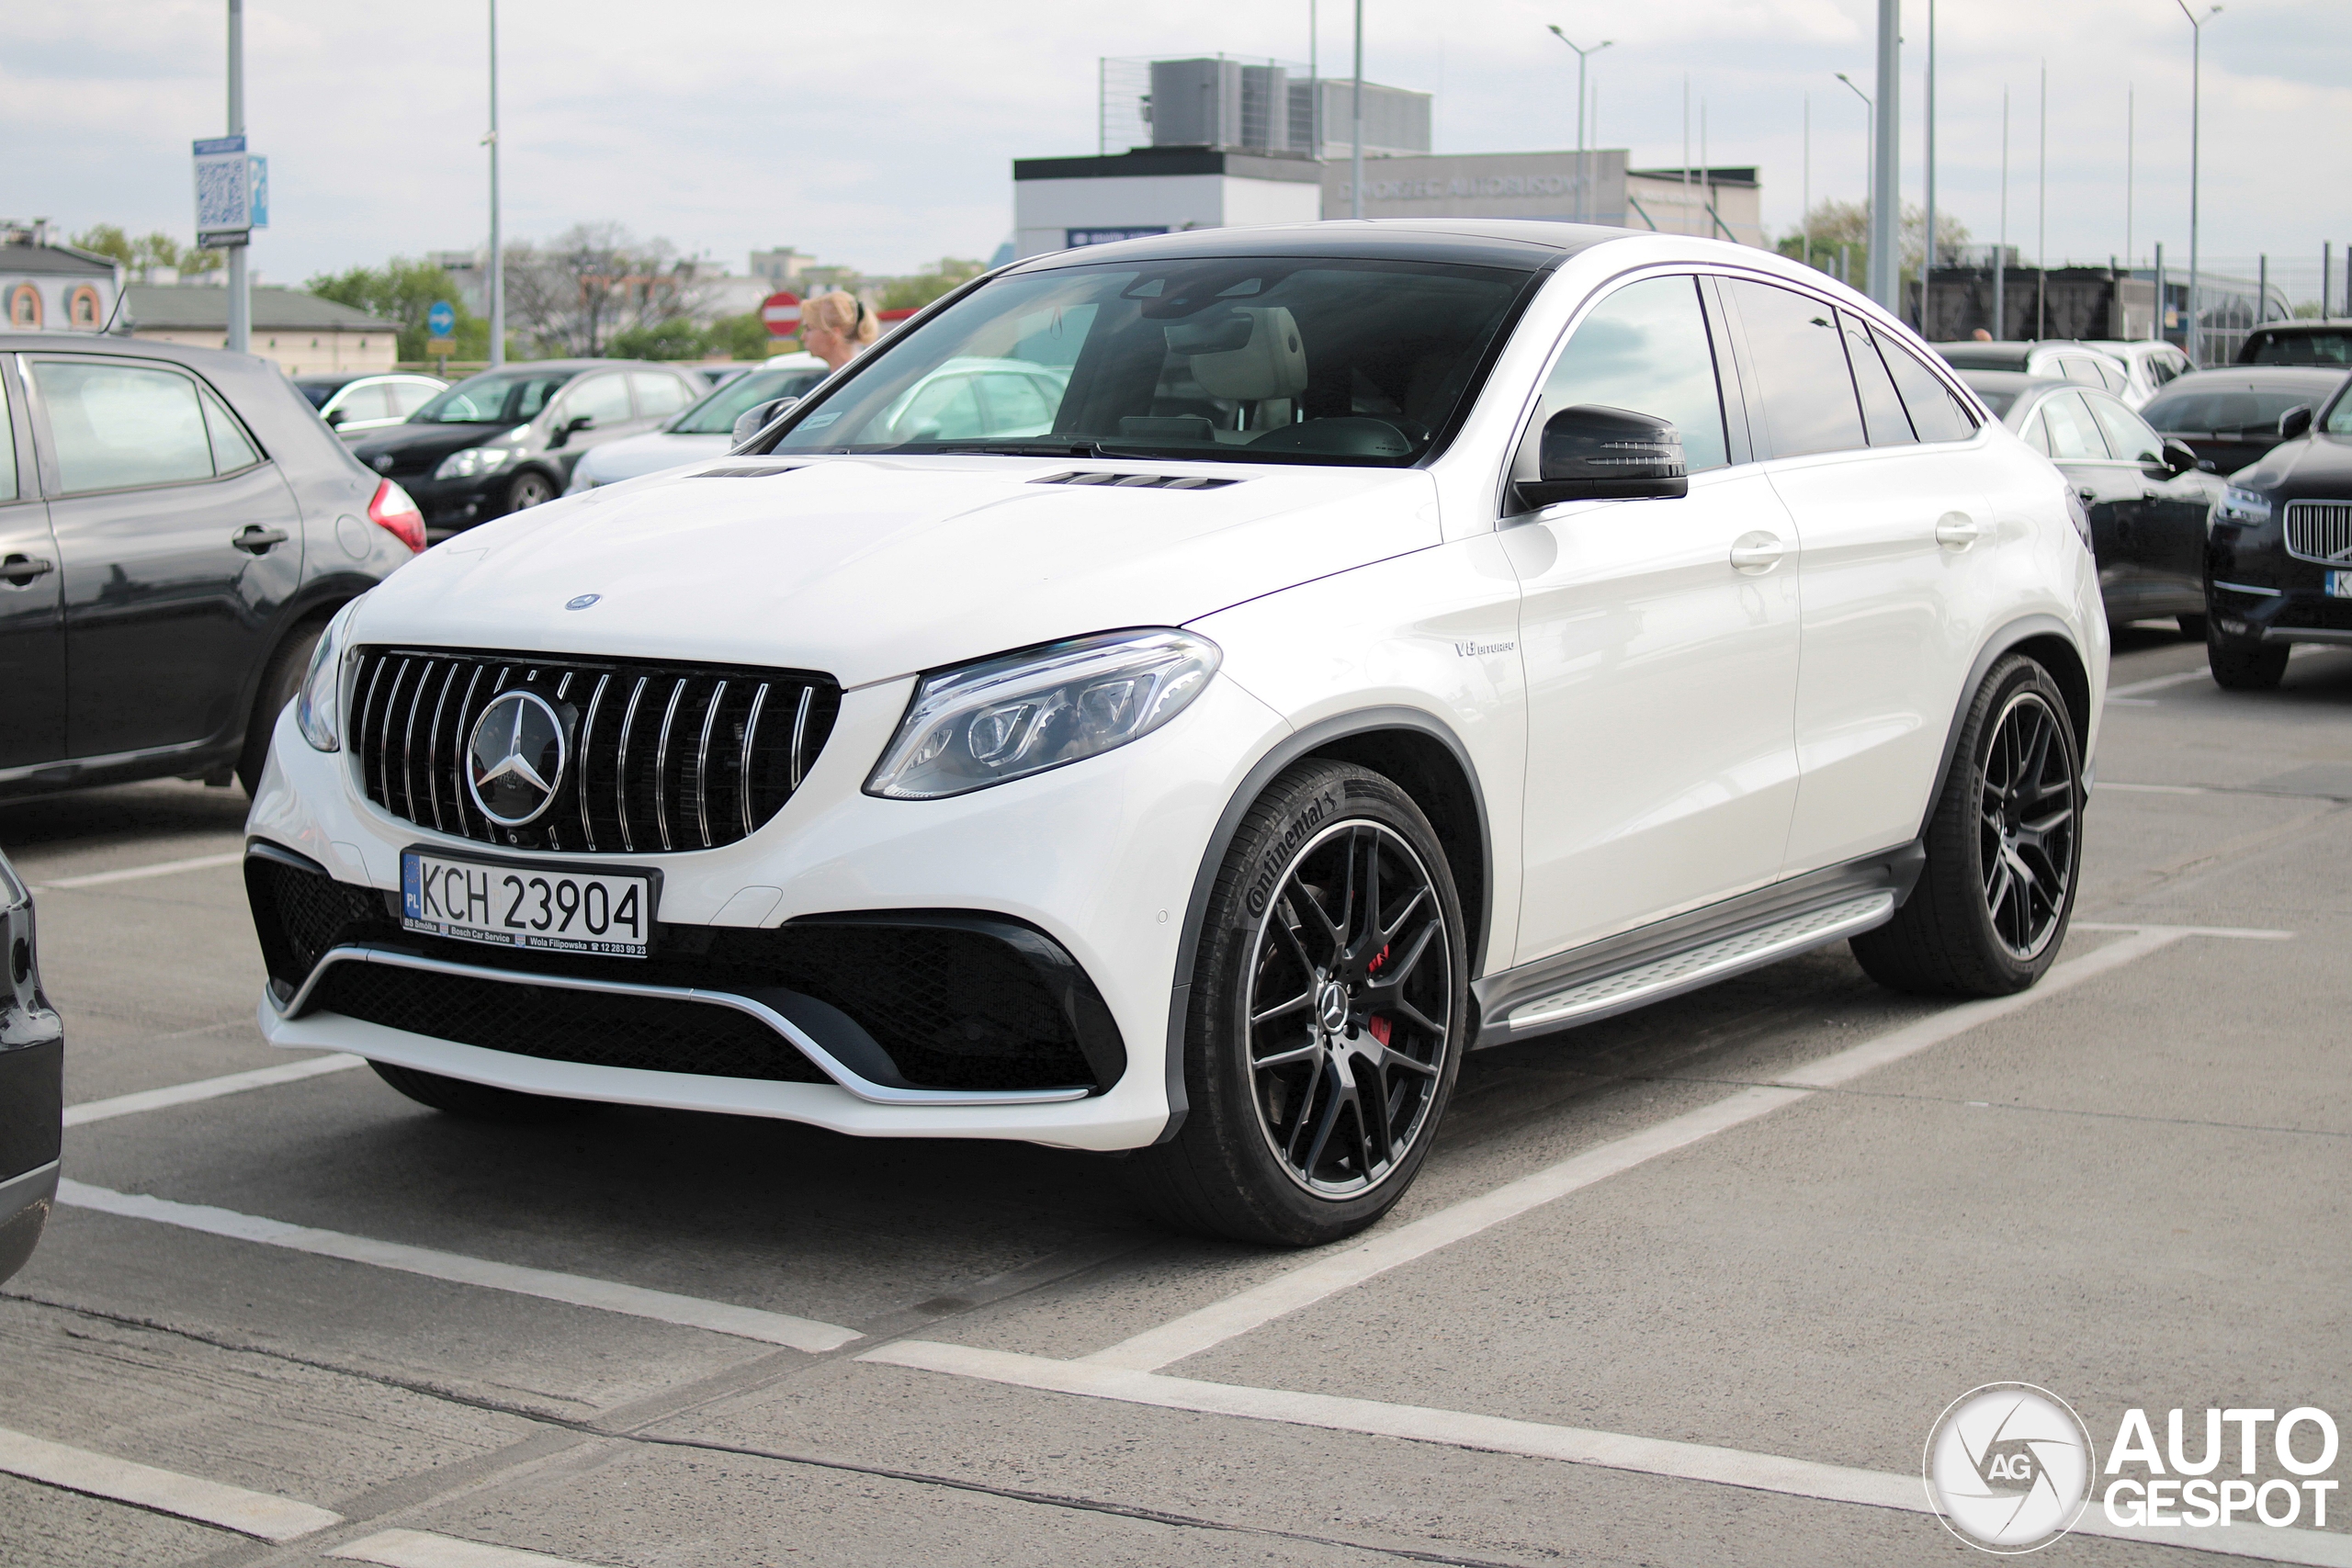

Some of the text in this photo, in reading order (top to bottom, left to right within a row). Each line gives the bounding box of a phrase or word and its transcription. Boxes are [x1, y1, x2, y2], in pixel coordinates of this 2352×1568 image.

[1454, 641, 1514, 657] V8 BITURBO
[1246, 796, 1326, 919] Continental
[406, 893, 420, 909] PL
[422, 862, 639, 939] KCH 23904
[404, 919, 413, 927] BS
[451, 926, 470, 938] Bosch
[472, 930, 484, 939] Car
[485, 931, 510, 943] Service
[530, 936, 548, 947] Wola
[548, 938, 587, 951] Filipowska
[601, 943, 610, 953] 12
[611, 944, 625, 953] 283
[626, 945, 636, 954] 99
[637, 946, 647, 955] 23
